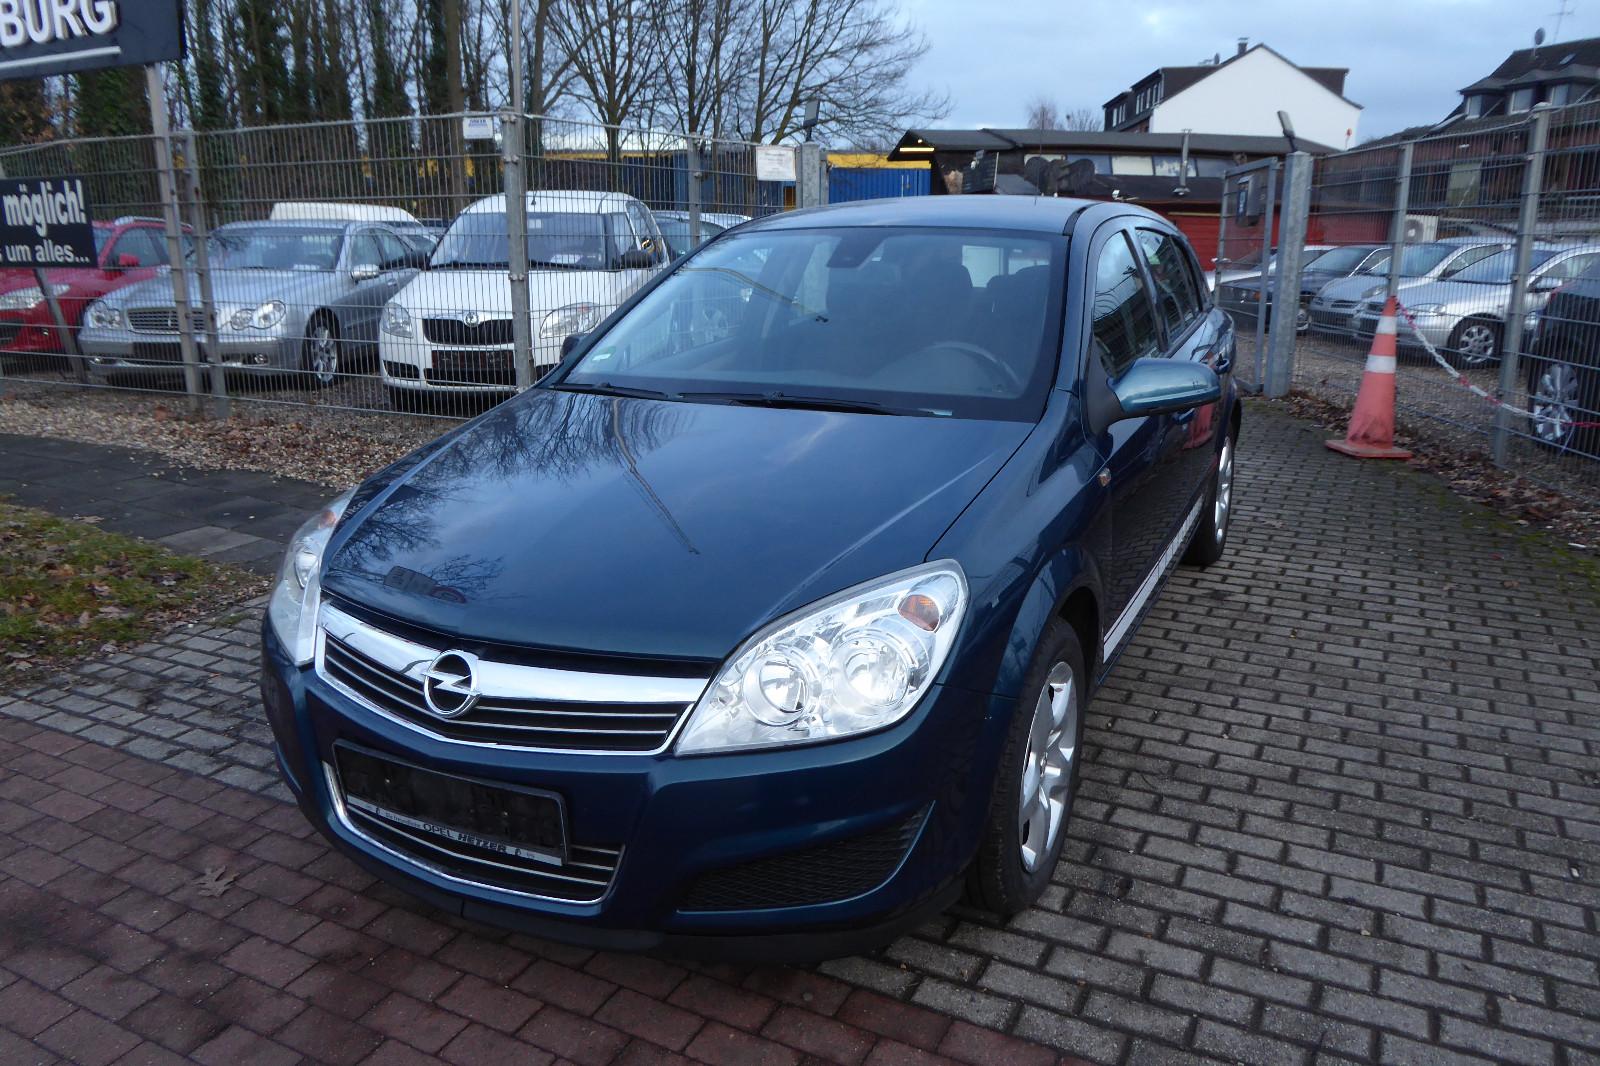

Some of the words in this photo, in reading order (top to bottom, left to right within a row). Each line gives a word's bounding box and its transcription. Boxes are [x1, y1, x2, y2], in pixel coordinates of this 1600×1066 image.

[0, 0, 117, 47] BURG
[3, 179, 87, 237] möglich!
[5, 245, 32, 262] um
[35, 239, 90, 262] alles...
[423, 823, 454, 838] OPEL
